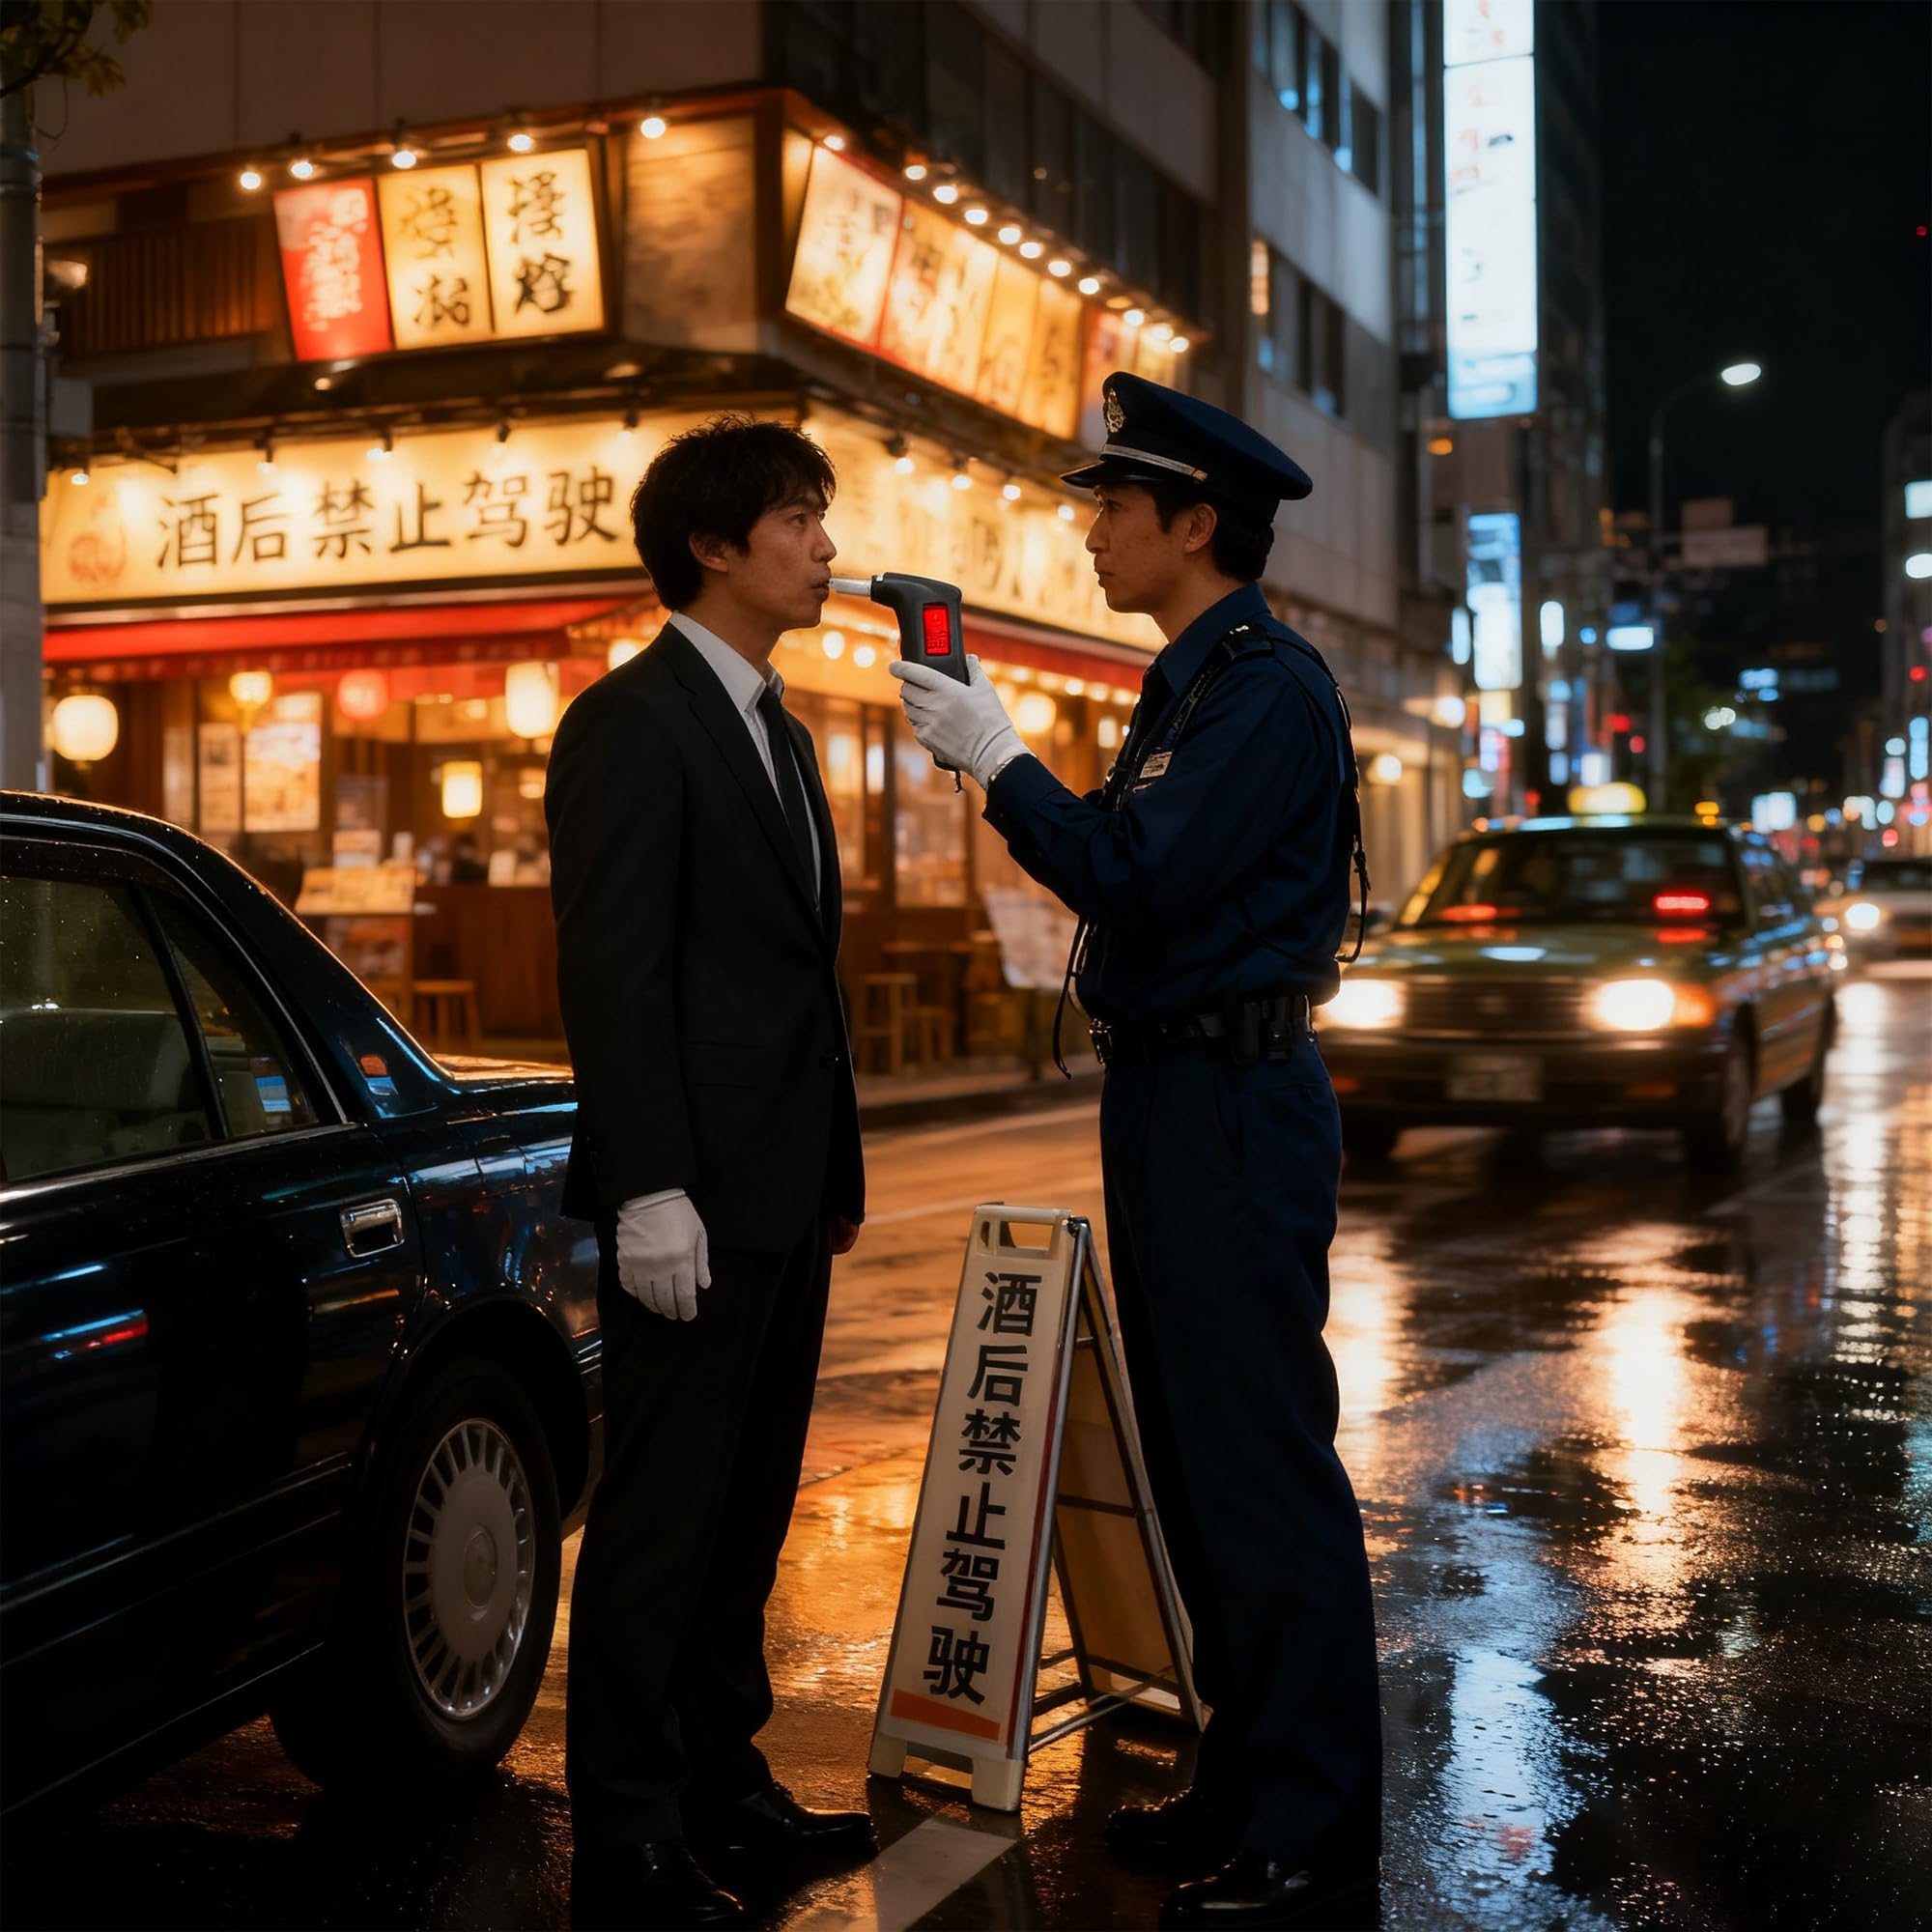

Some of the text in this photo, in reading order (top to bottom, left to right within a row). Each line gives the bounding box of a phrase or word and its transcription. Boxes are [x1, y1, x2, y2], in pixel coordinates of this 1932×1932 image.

[156, 466, 620, 569] 酒后禁止驾驶
[923, 1271, 1042, 1706] 酒后禁止驾驶
